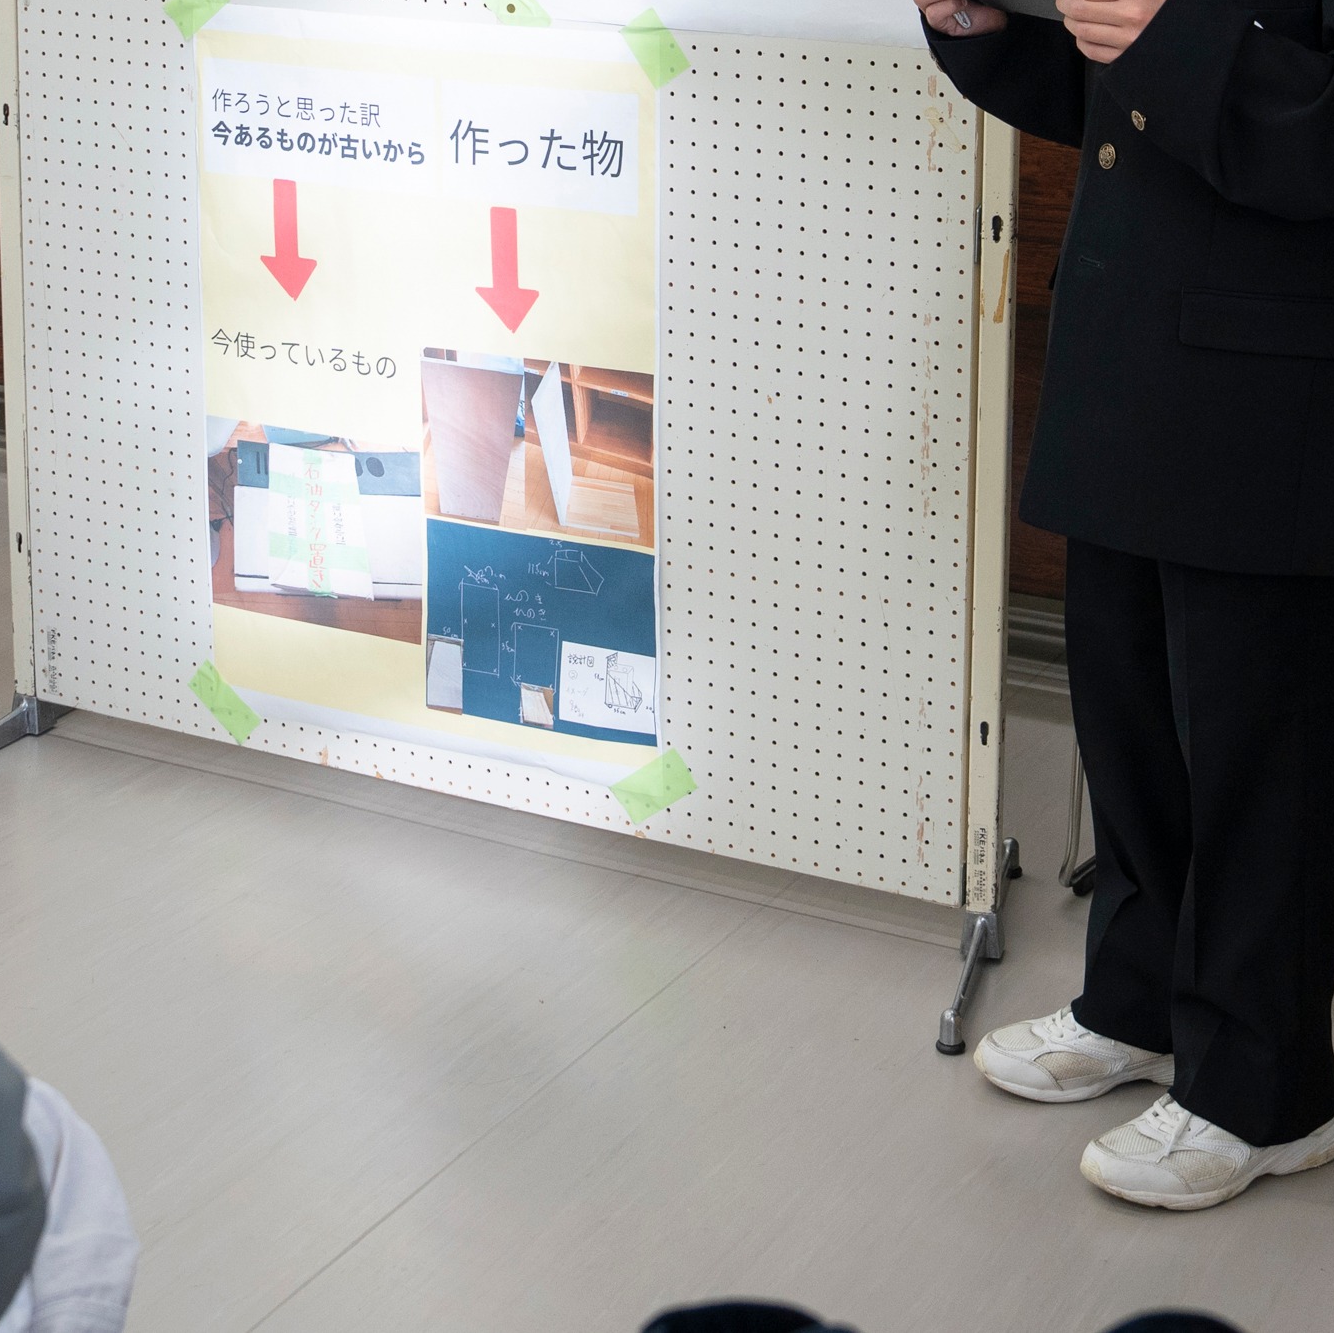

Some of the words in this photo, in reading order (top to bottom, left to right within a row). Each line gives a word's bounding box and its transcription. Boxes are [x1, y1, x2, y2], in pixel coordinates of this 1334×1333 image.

[211, 88, 381, 128] 作ろうと思った訳
[211, 120, 425, 165] 今あるものが古いから
[449, 118, 624, 178] 作った物
[211, 327, 397, 379] 今使っているもの
